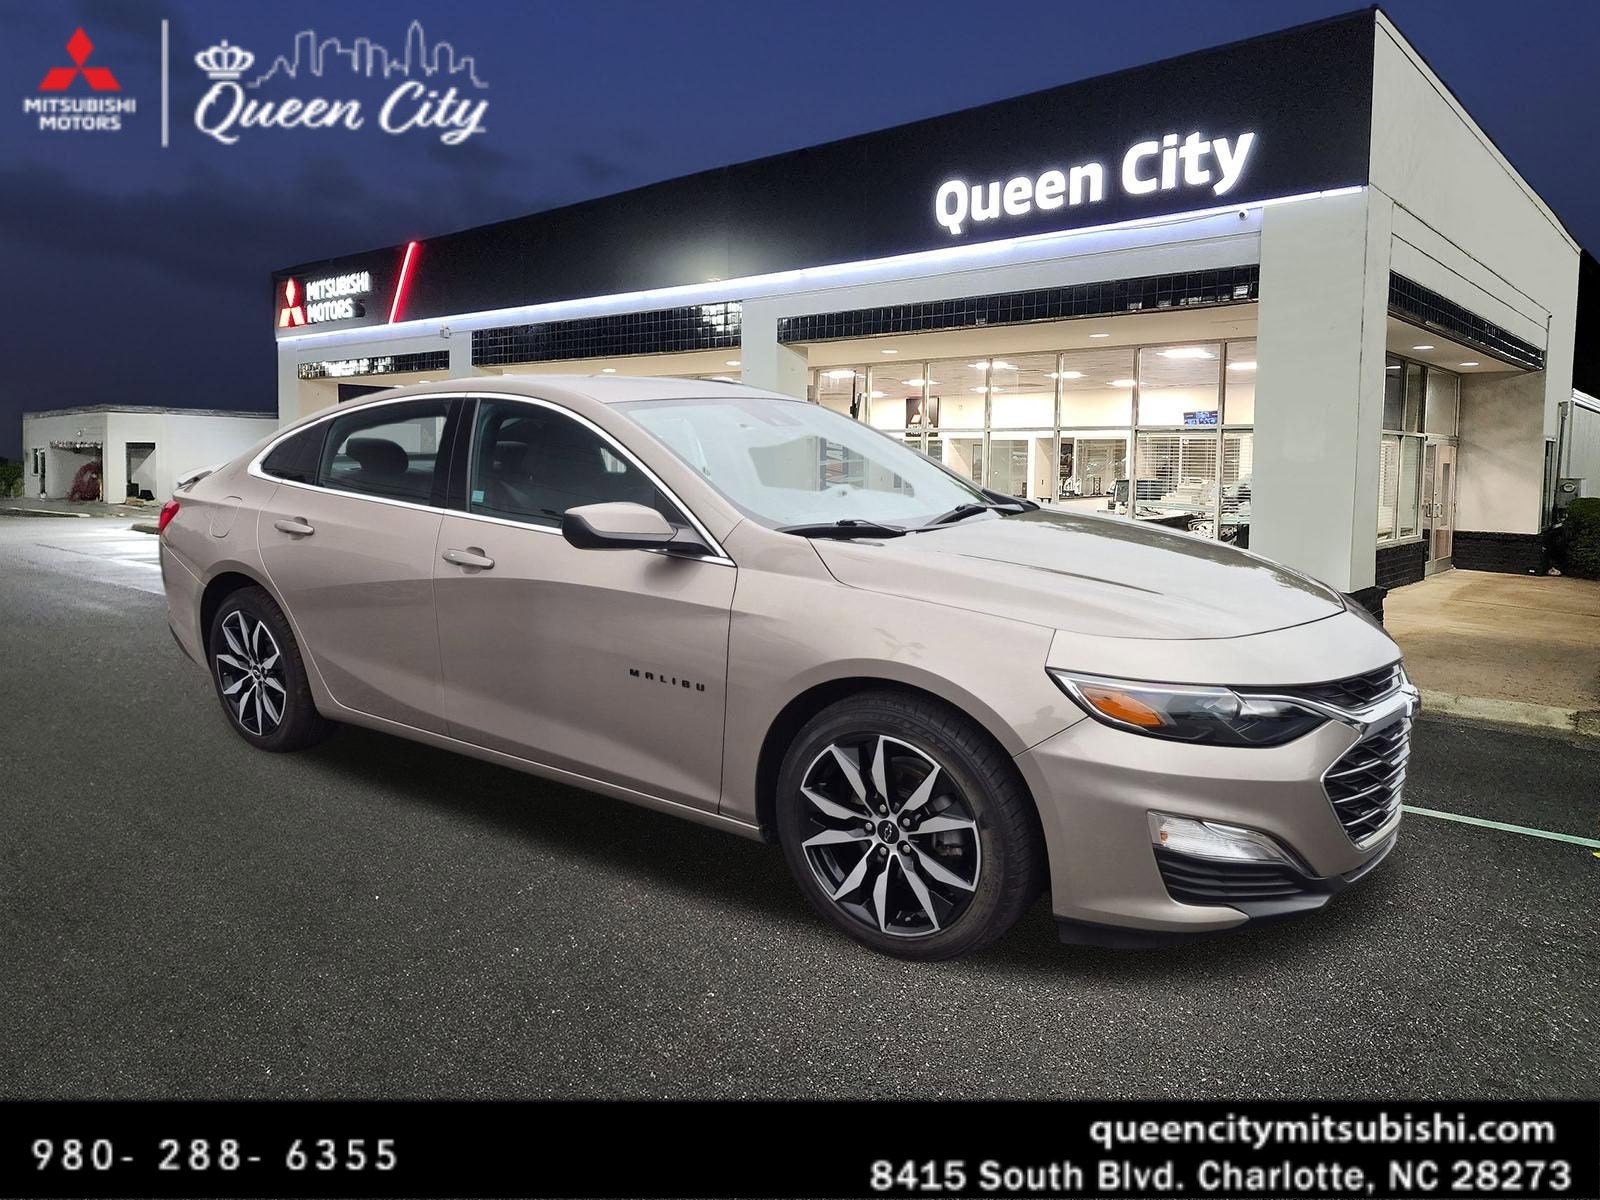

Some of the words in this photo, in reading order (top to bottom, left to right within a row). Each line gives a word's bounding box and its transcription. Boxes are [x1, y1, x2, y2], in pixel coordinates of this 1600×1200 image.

[935, 160, 1105, 235] Queen
[1121, 131, 1256, 196] City
[306, 271, 370, 301] MITSUBISHI
[307, 298, 354, 323] MOTORS
[629, 668, 706, 692] MALIBU
